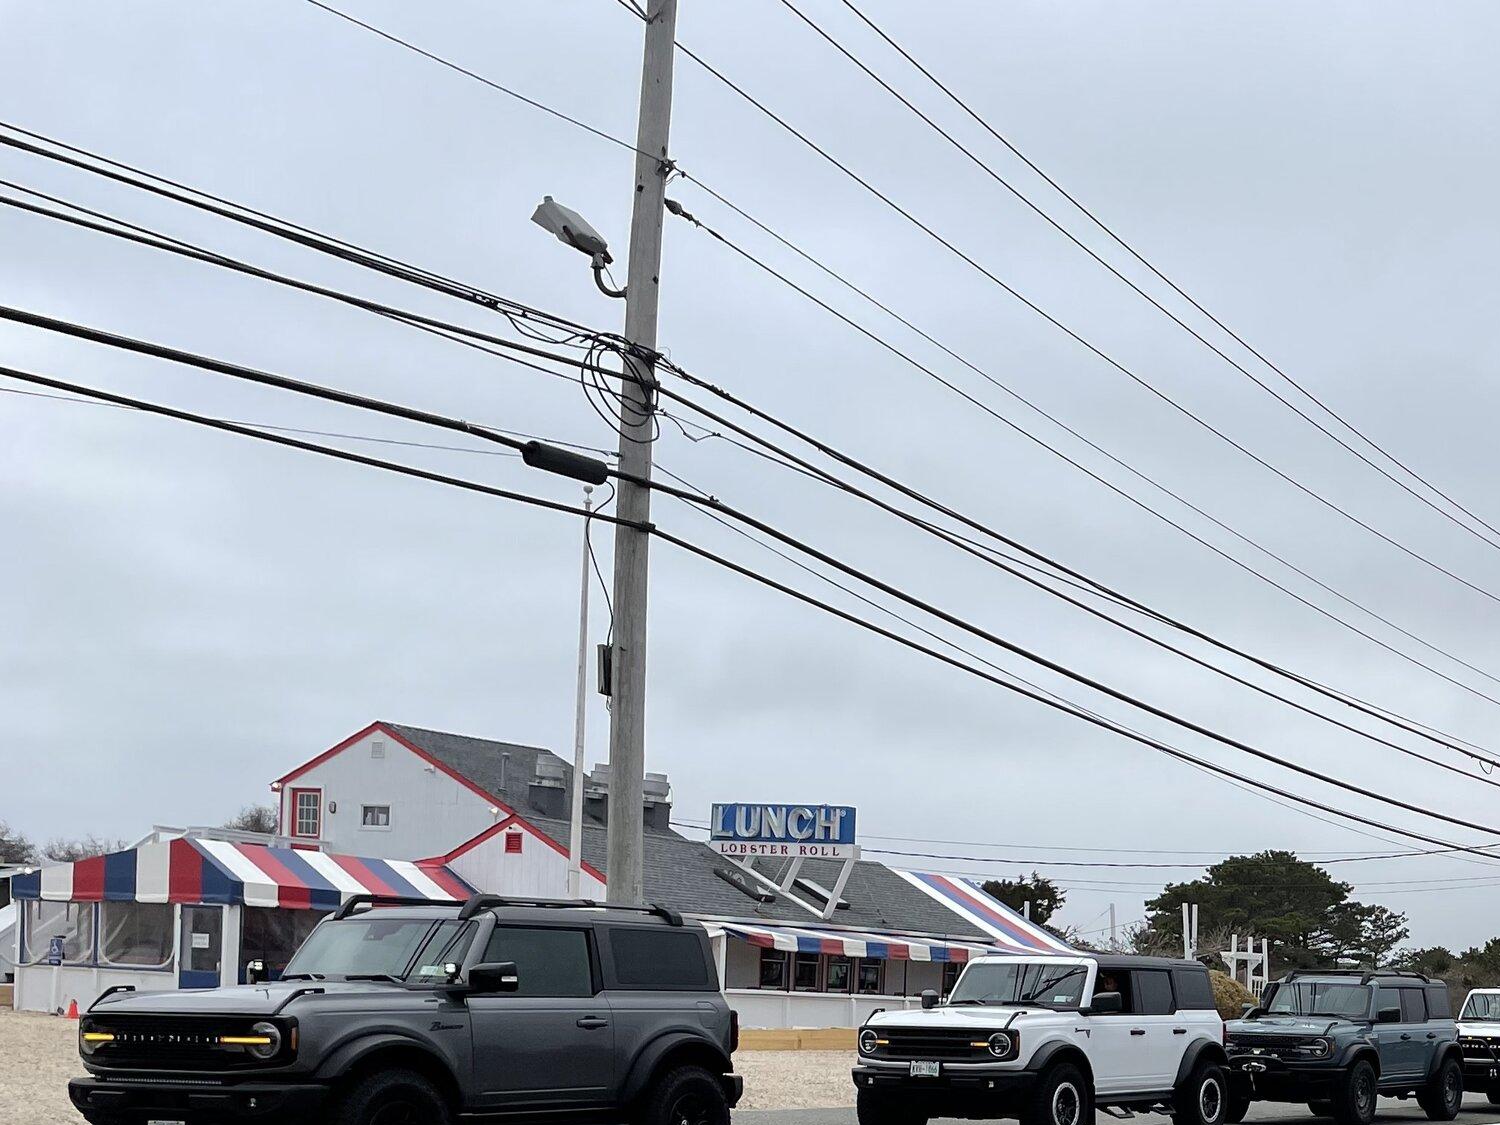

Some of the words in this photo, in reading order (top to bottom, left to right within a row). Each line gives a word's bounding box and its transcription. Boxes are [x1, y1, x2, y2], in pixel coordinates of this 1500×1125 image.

[711, 805, 841, 841] LUNCH
[721, 843, 788, 855] LOBSTER
[799, 845, 840, 857] ROLL
